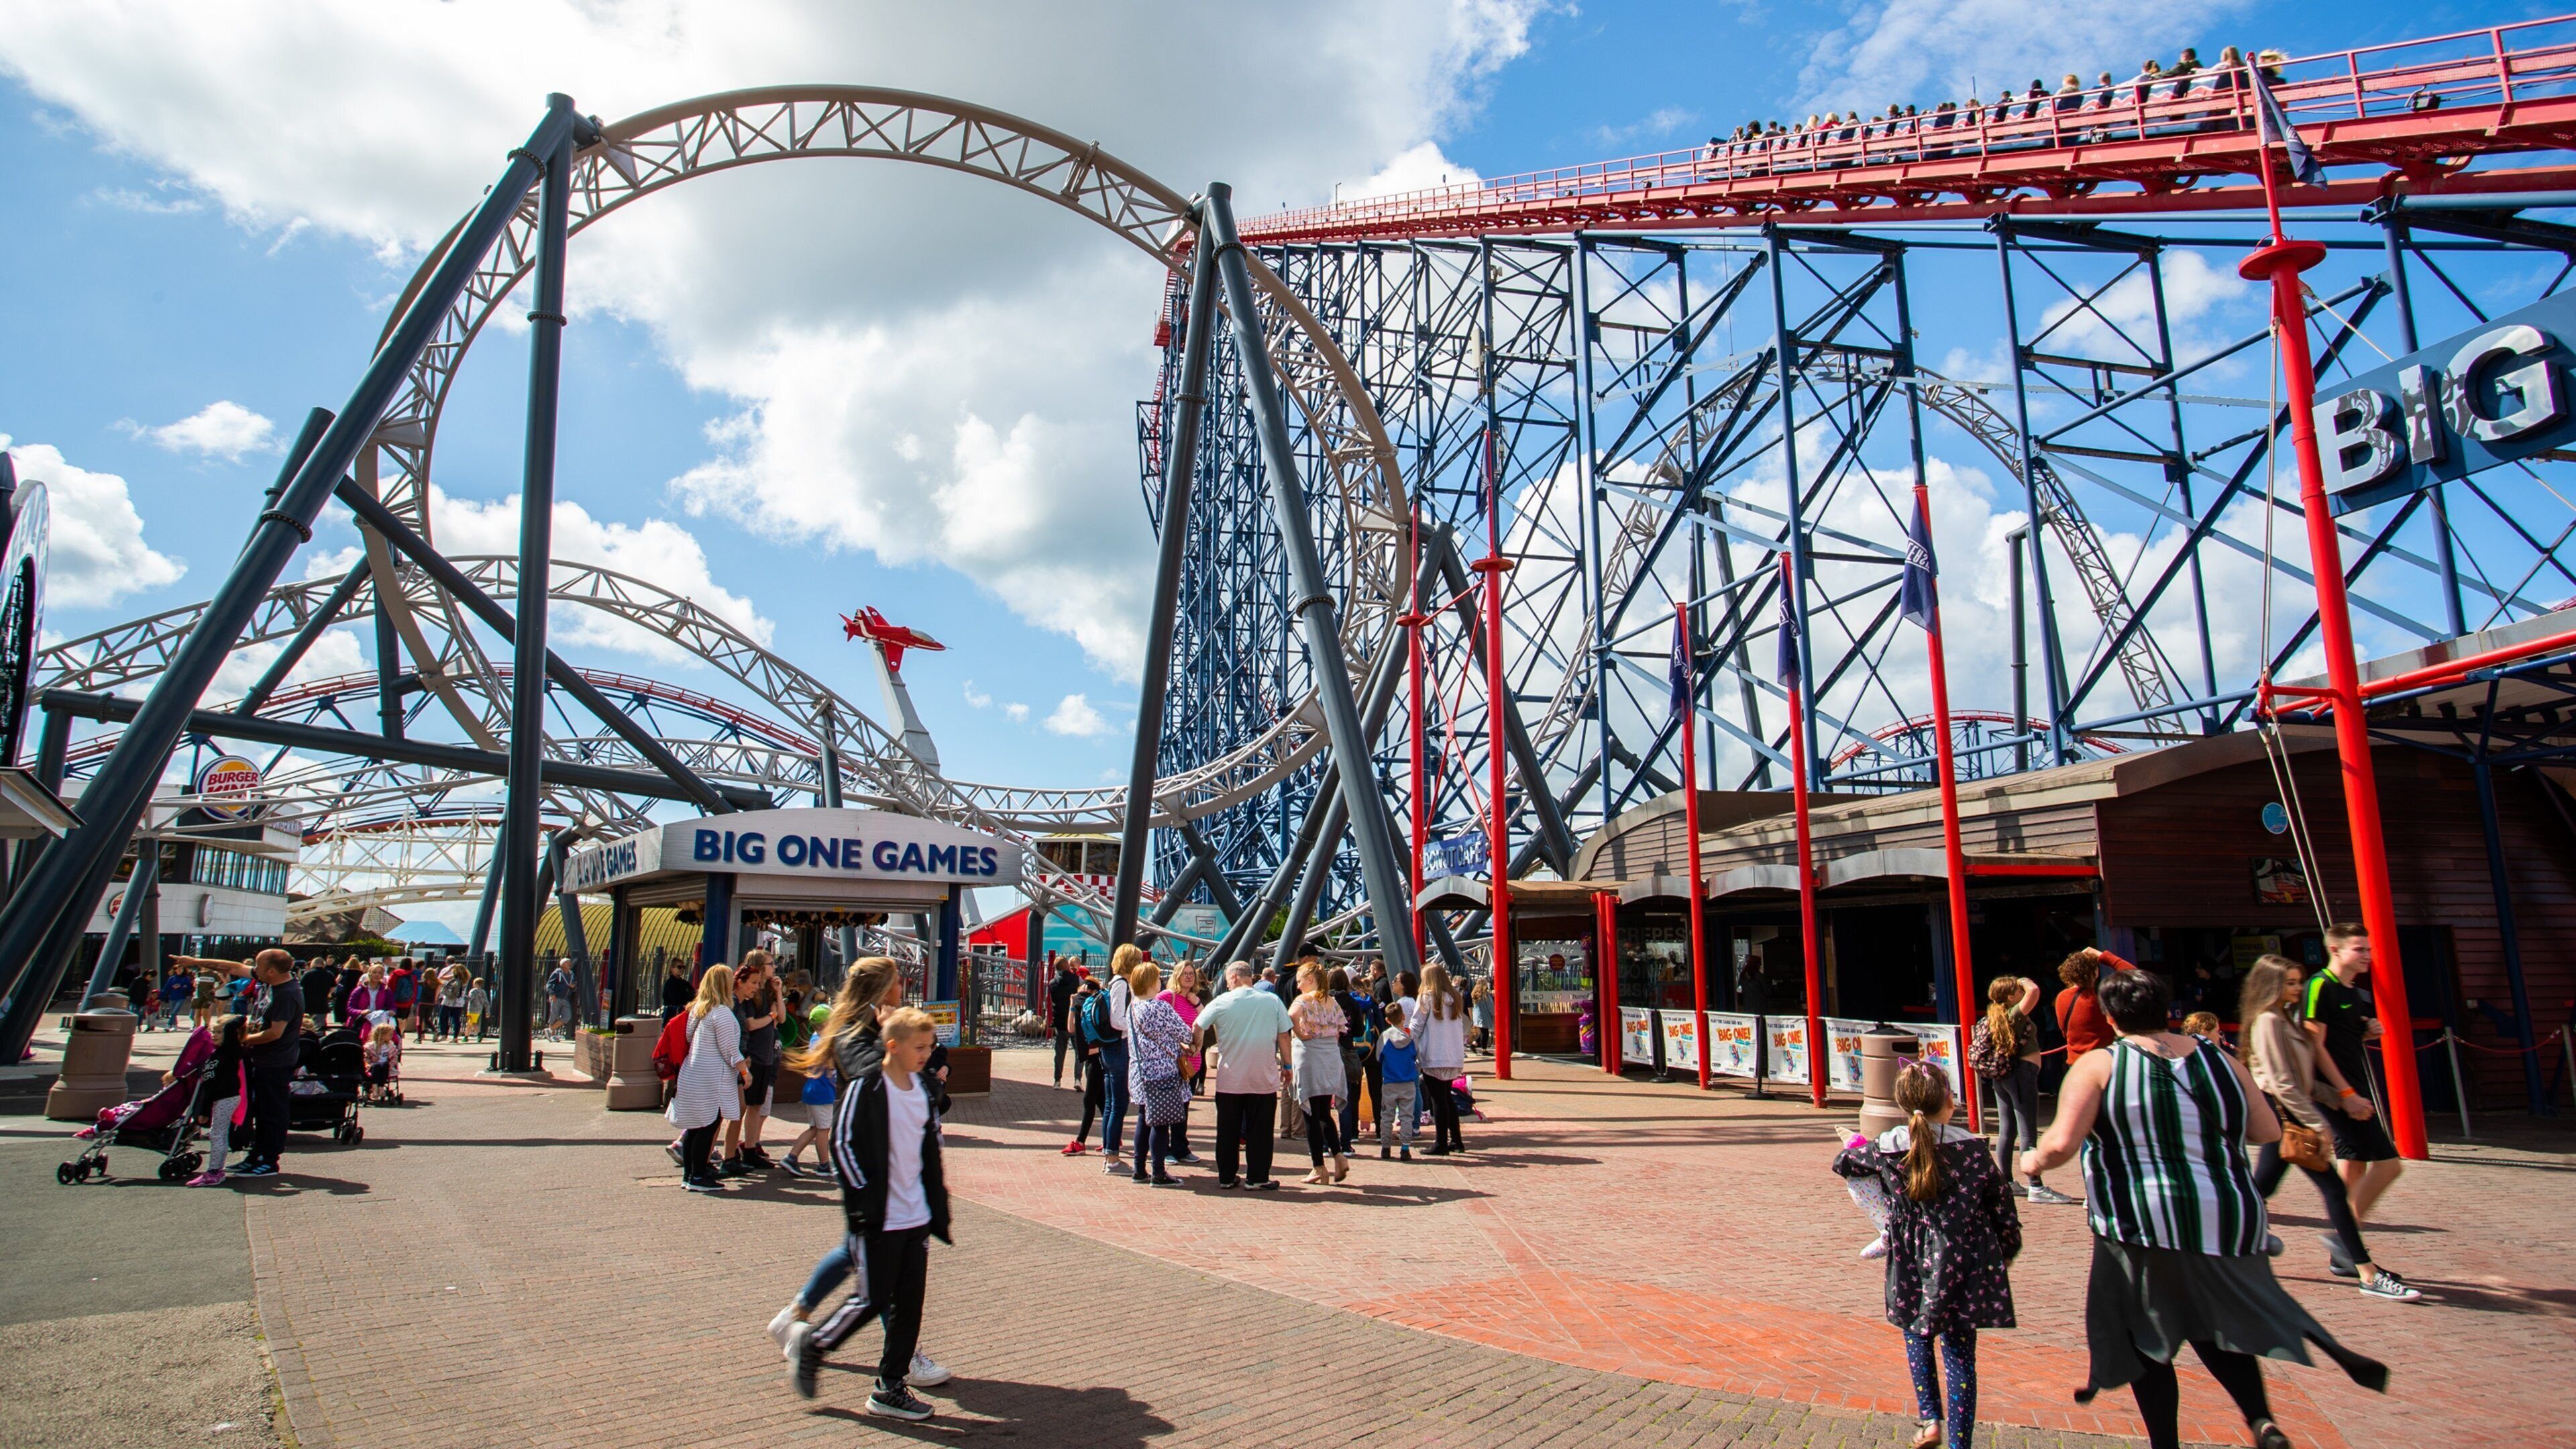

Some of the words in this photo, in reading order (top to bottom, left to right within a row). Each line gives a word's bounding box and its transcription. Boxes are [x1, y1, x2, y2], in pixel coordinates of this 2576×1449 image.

[2312, 325, 2567, 495] BIG
[207, 772, 258, 785] BURGER
[606, 840, 637, 877] GAMES
[694, 828, 766, 864] BIG
[777, 835, 863, 870] ONE
[872, 841, 998, 876] GAMES
[1423, 847, 1455, 871] DONUT
[1626, 1021, 1635, 1033] BIG
[1637, 1020, 1648, 1031] ONE!
[1668, 1025, 1679, 1038] BIG
[1680, 1023, 1693, 1035] ONE!
[1717, 1028, 1732, 1041] BIG
[1733, 1027, 1751, 1040] ONE!
[1773, 1032, 1786, 1047] BIG
[1788, 1030, 1803, 1044] ONE!
[1835, 1037, 1851, 1053] BIG
[1927, 1040, 1949, 1057] ONE!
